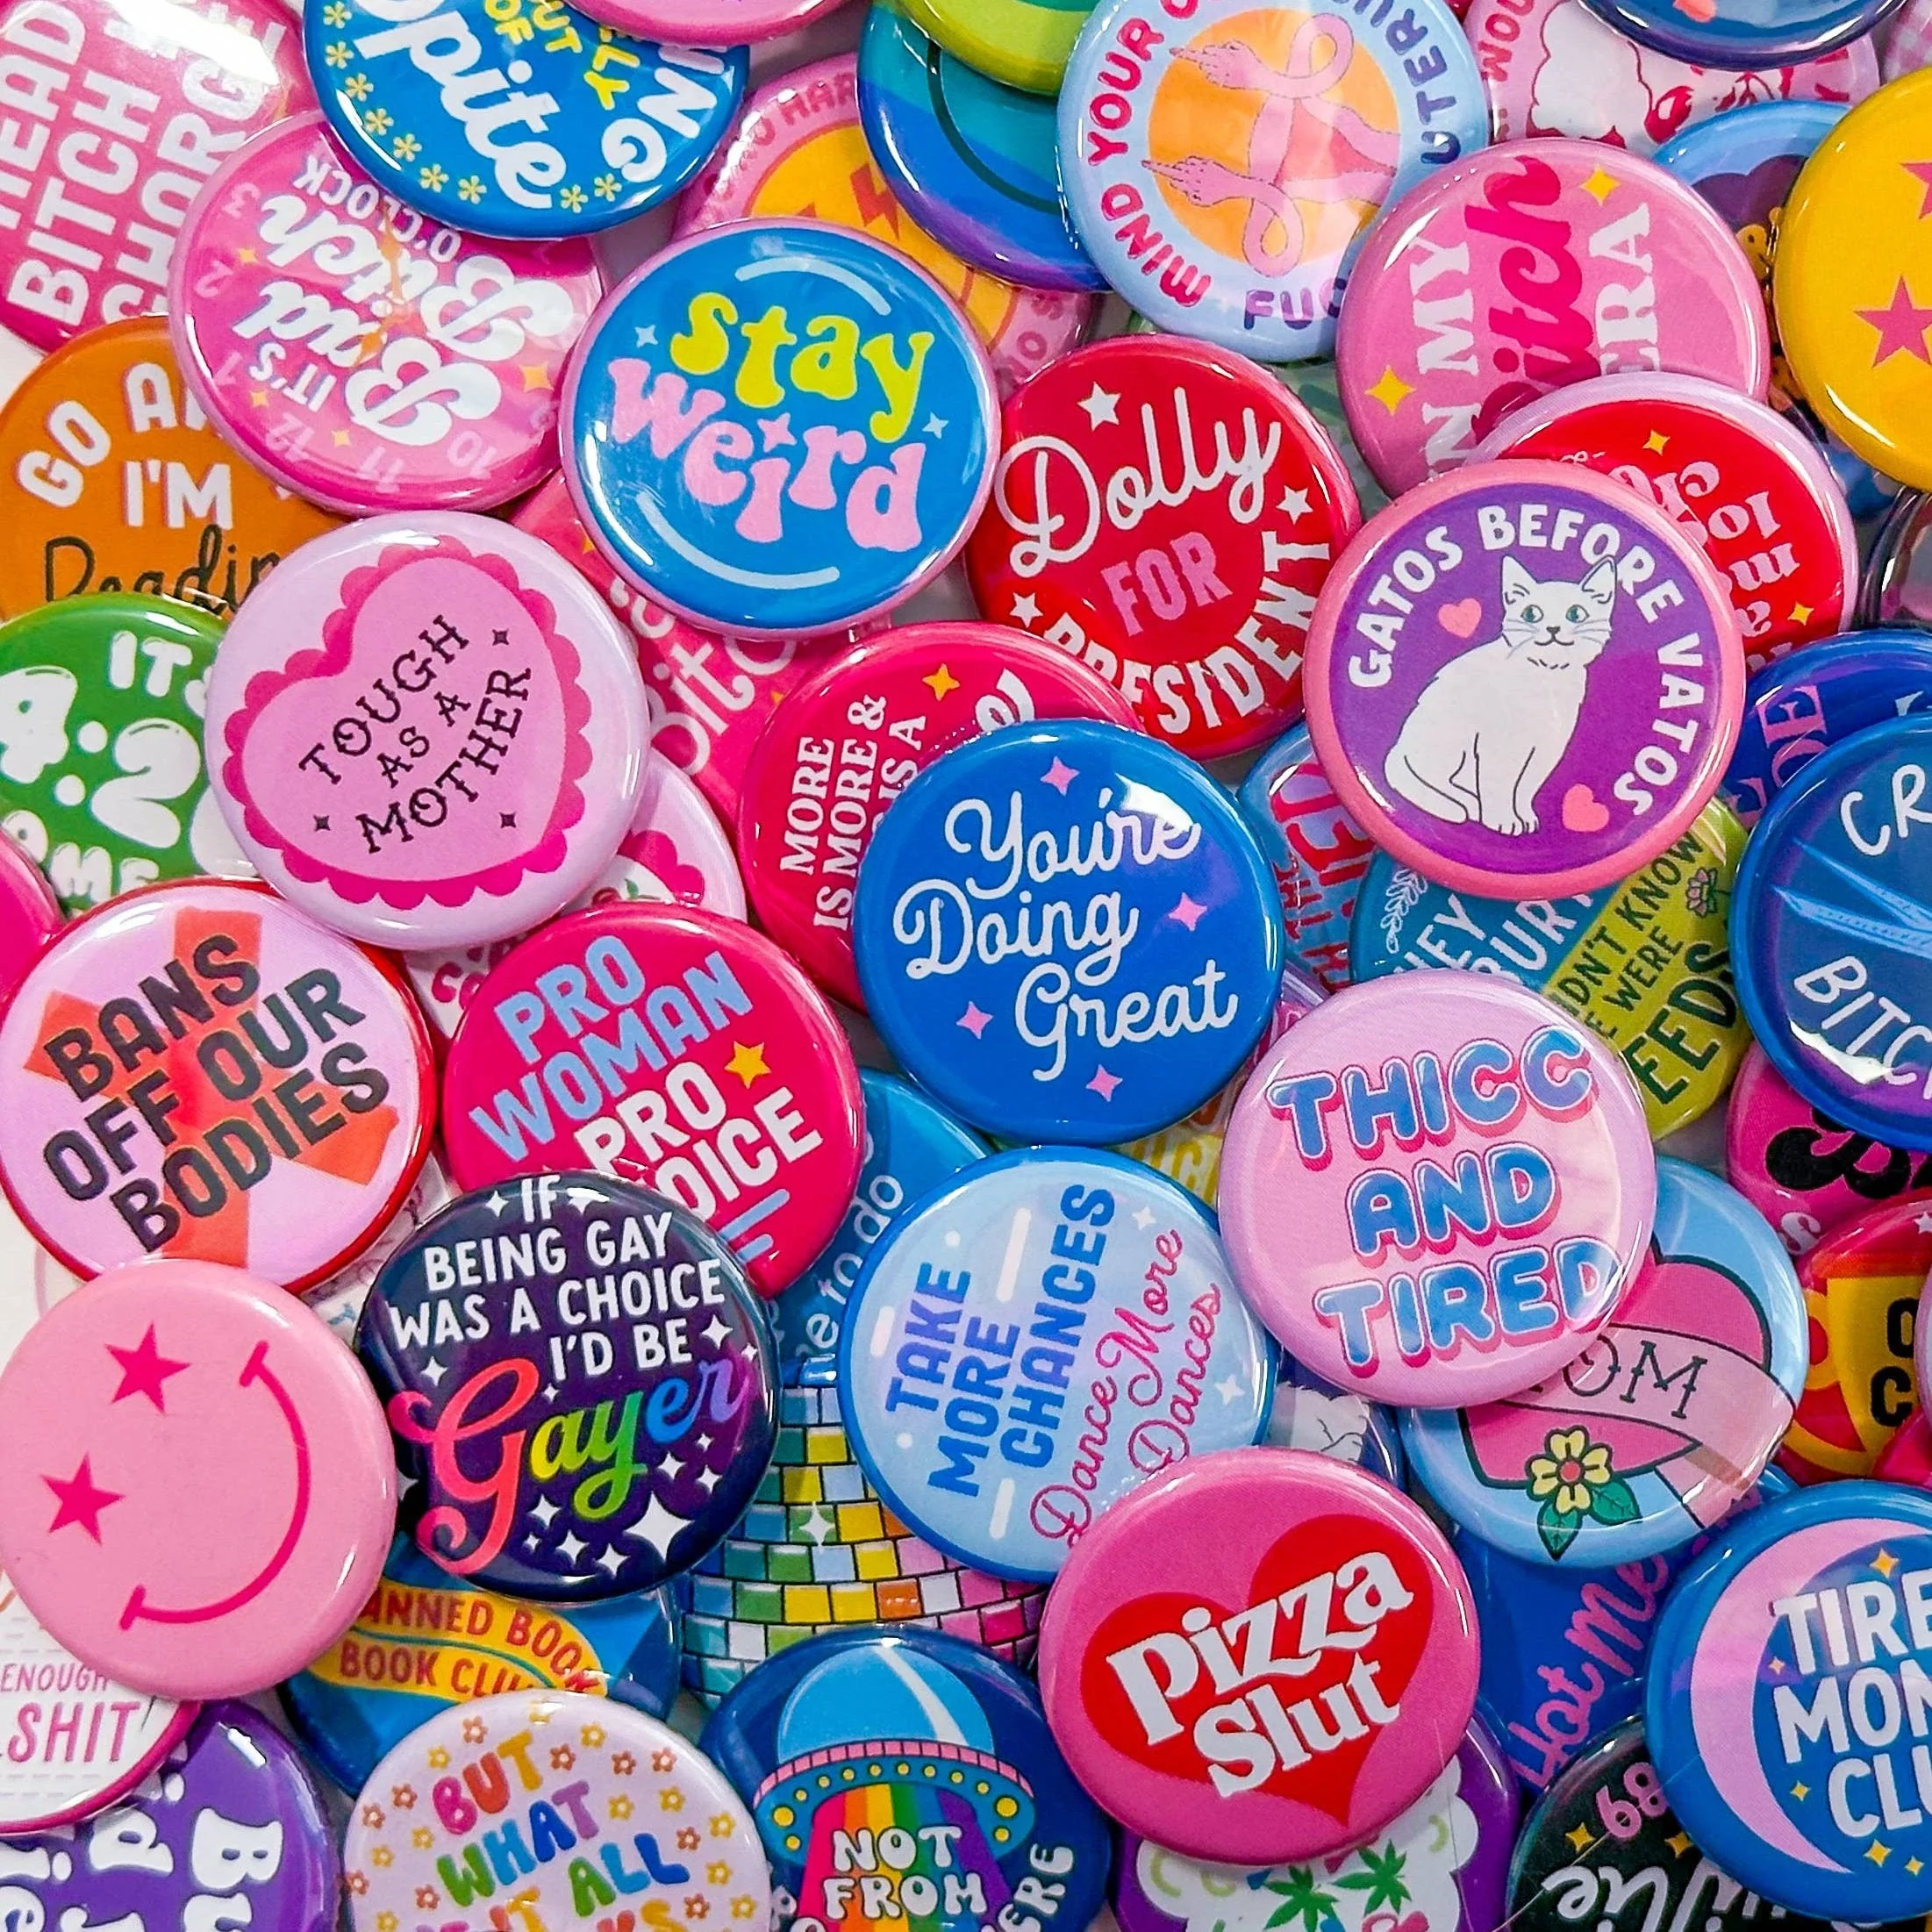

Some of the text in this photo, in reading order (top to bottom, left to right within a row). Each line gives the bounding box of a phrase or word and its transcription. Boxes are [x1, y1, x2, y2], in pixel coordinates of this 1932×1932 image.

[354, 0, 566, 209] pite
[1088, 18, 1211, 307] MIND YOUR
[8, 70, 160, 325] BITCH
[261, 193, 573, 362] Bitch
[1409, 234, 1480, 376] MY
[1465, 156, 1601, 439] itch
[233, 282, 501, 447] Bad
[17, 401, 112, 508] GO
[124, 461, 233, 529] I'M
[995, 386, 1283, 578] Dolly
[1100, 532, 1233, 636] FOR
[299, 615, 469, 785] TOUGH
[1348, 526, 1462, 688] GATOS
[1478, 504, 1685, 623] BEFORE
[1614, 633, 1704, 817] VATOS
[355, 668, 531, 854] MOTHER
[377, 691, 471, 788] AS A
[889, 714, 928, 750] A
[779, 735, 836, 876] MORE
[813, 693, 888, 931] IS MORE &
[945, 787, 1201, 900] You're
[894, 878, 1139, 986] Doing
[1615, 832, 1703, 931] KNOW
[45, 934, 261, 1102] BANS
[494, 935, 645, 1065] PRO
[1015, 959, 1238, 1082] Great
[1603, 927, 1682, 1015] WERE
[1794, 955, 1932, 1100] BITC
[43, 1069, 179, 1201] OFF
[196, 969, 365, 1101] OUR
[469, 950, 753, 1163] WOMAN
[574, 1062, 726, 1175] PRO
[1268, 1025, 1601, 1170] THICC
[111, 1042, 389, 1253] BODIES
[519, 1176, 561, 1222] IF
[1346, 1142, 1561, 1268] AND
[389, 1298, 489, 1352] WAS
[511, 1288, 540, 1337] A
[557, 1258, 726, 1327] CHOICE
[425, 1211, 674, 1292] BEING GAY
[1313, 1235, 1623, 1378] TIRED
[549, 1318, 691, 1383] I'D BE
[888, 1262, 972, 1415] TAKE
[1000, 1183, 1115, 1469] CHANCES
[1030, 1377, 1117, 1548] Dance
[1095, 1228, 1183, 1407] More
[1127, 1283, 1221, 1475] Dances
[1563, 1333, 1707, 1420] OM
[389, 1351, 752, 1575] Gayer
[928, 1317, 1020, 1497] MORE
[340, 1642, 533, 1699] BOOK CLU
[361, 1586, 493, 1635] ANNED
[1107, 1551, 1413, 1745] Pizza
[8, 1702, 140, 1763] SHIT
[434, 1732, 543, 1834] BUT
[1193, 1652, 1400, 1799] Slut
[437, 1780, 600, 1907] WHAT
[569, 1833, 690, 1917] ALL
[823, 1873, 986, 1920] FROM
[834, 1826, 962, 1871] NOT
